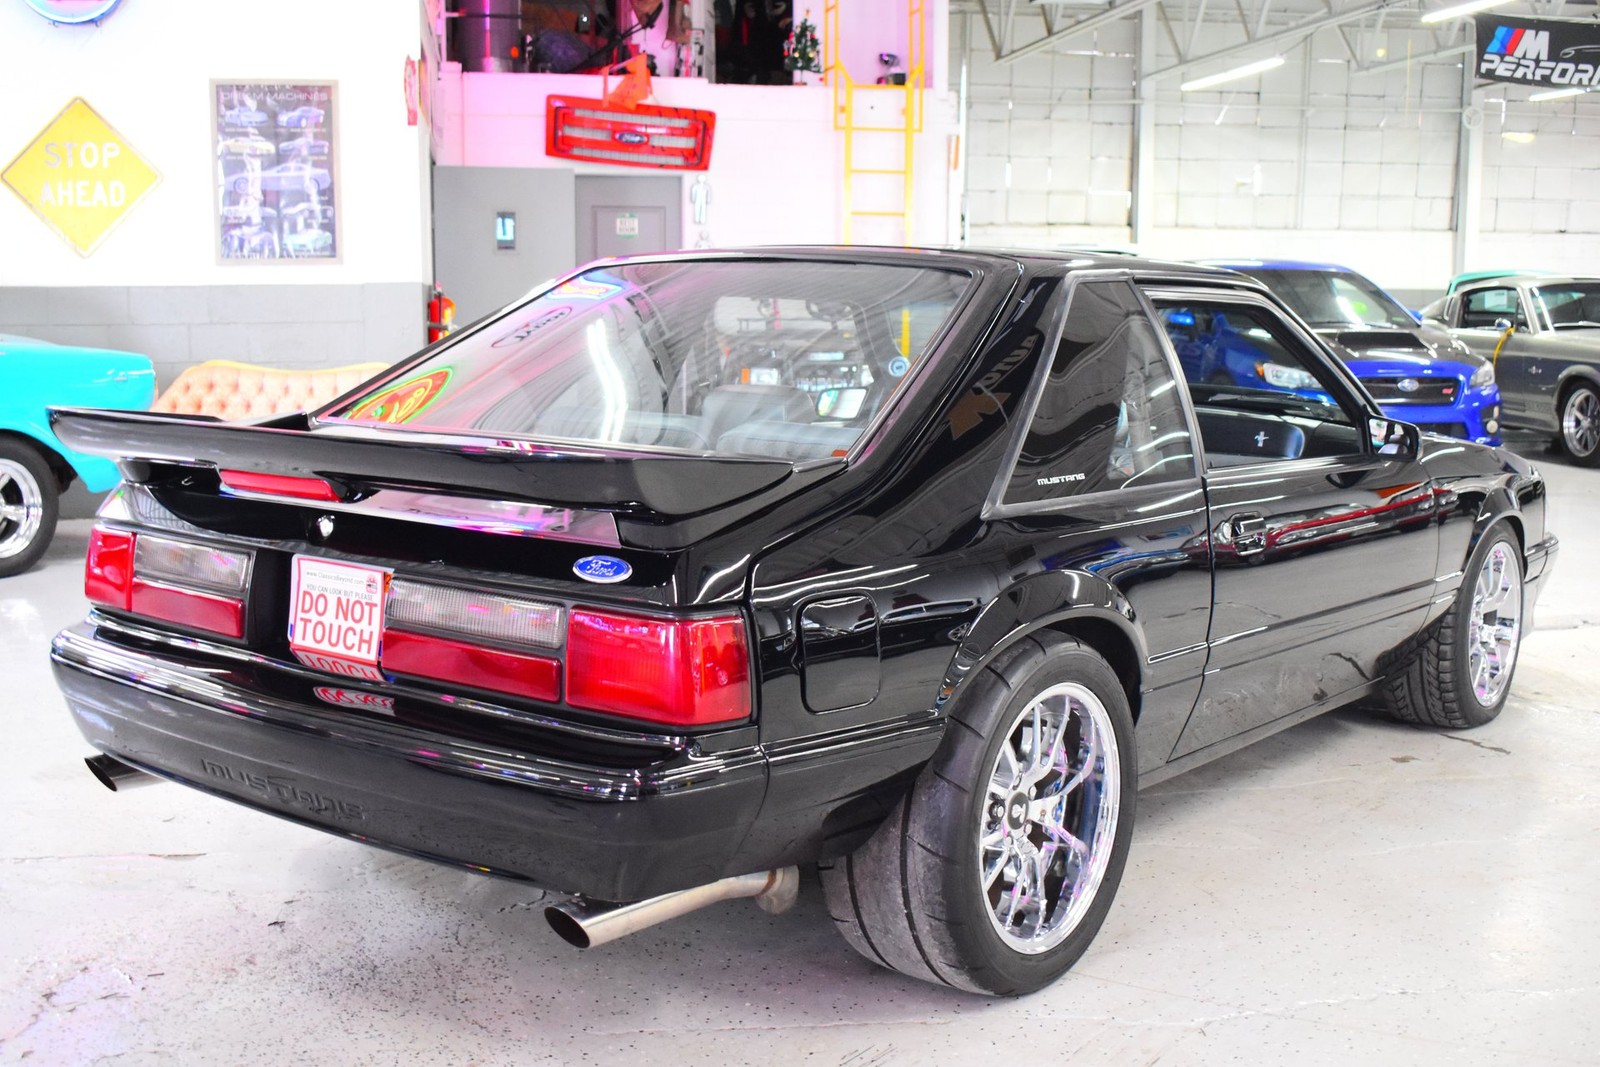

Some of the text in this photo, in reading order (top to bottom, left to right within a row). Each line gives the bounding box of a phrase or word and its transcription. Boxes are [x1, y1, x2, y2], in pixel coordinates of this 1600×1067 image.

[1513, 28, 1550, 60] M
[268, 91, 328, 101] MACHINES
[44, 141, 121, 169] STOP
[40, 179, 126, 208] AHEAD
[1036, 473, 1086, 486] MUSTANG
[585, 559, 618, 577] Ford
[306, 583, 373, 601] YOU CAN LOOK BUT PLEASE
[301, 590, 378, 626] DO NOT
[299, 618, 374, 655] TOUCH
[200, 758, 367, 821] MUSTANG
